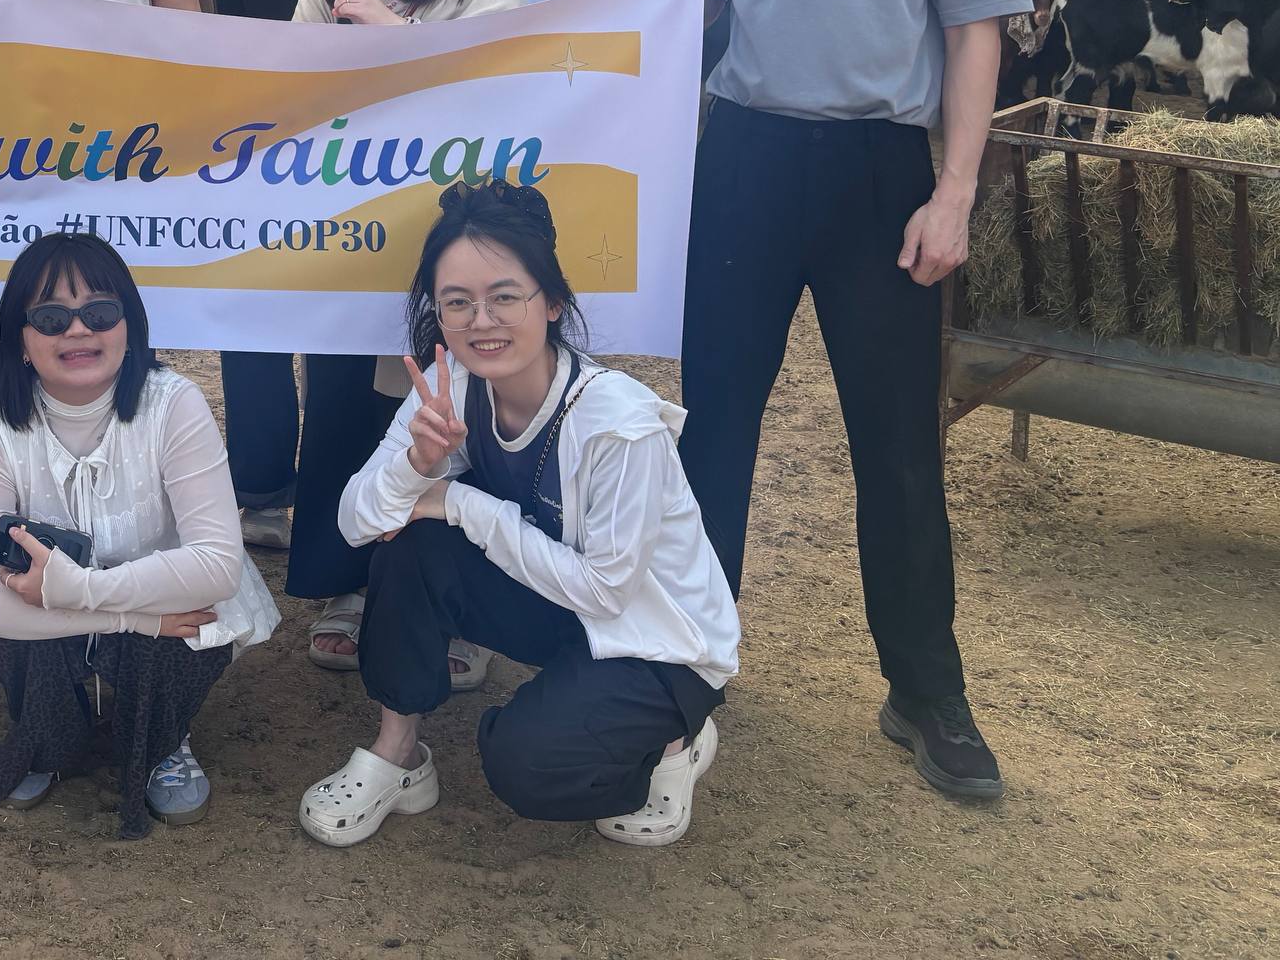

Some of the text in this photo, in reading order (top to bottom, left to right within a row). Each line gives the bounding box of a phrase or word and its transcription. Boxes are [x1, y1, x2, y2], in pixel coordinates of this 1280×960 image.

[197, 117, 550, 186] Taiwan
[56, 213, 246, 250] #UNFCCC
[258, 219, 387, 253] COP30
